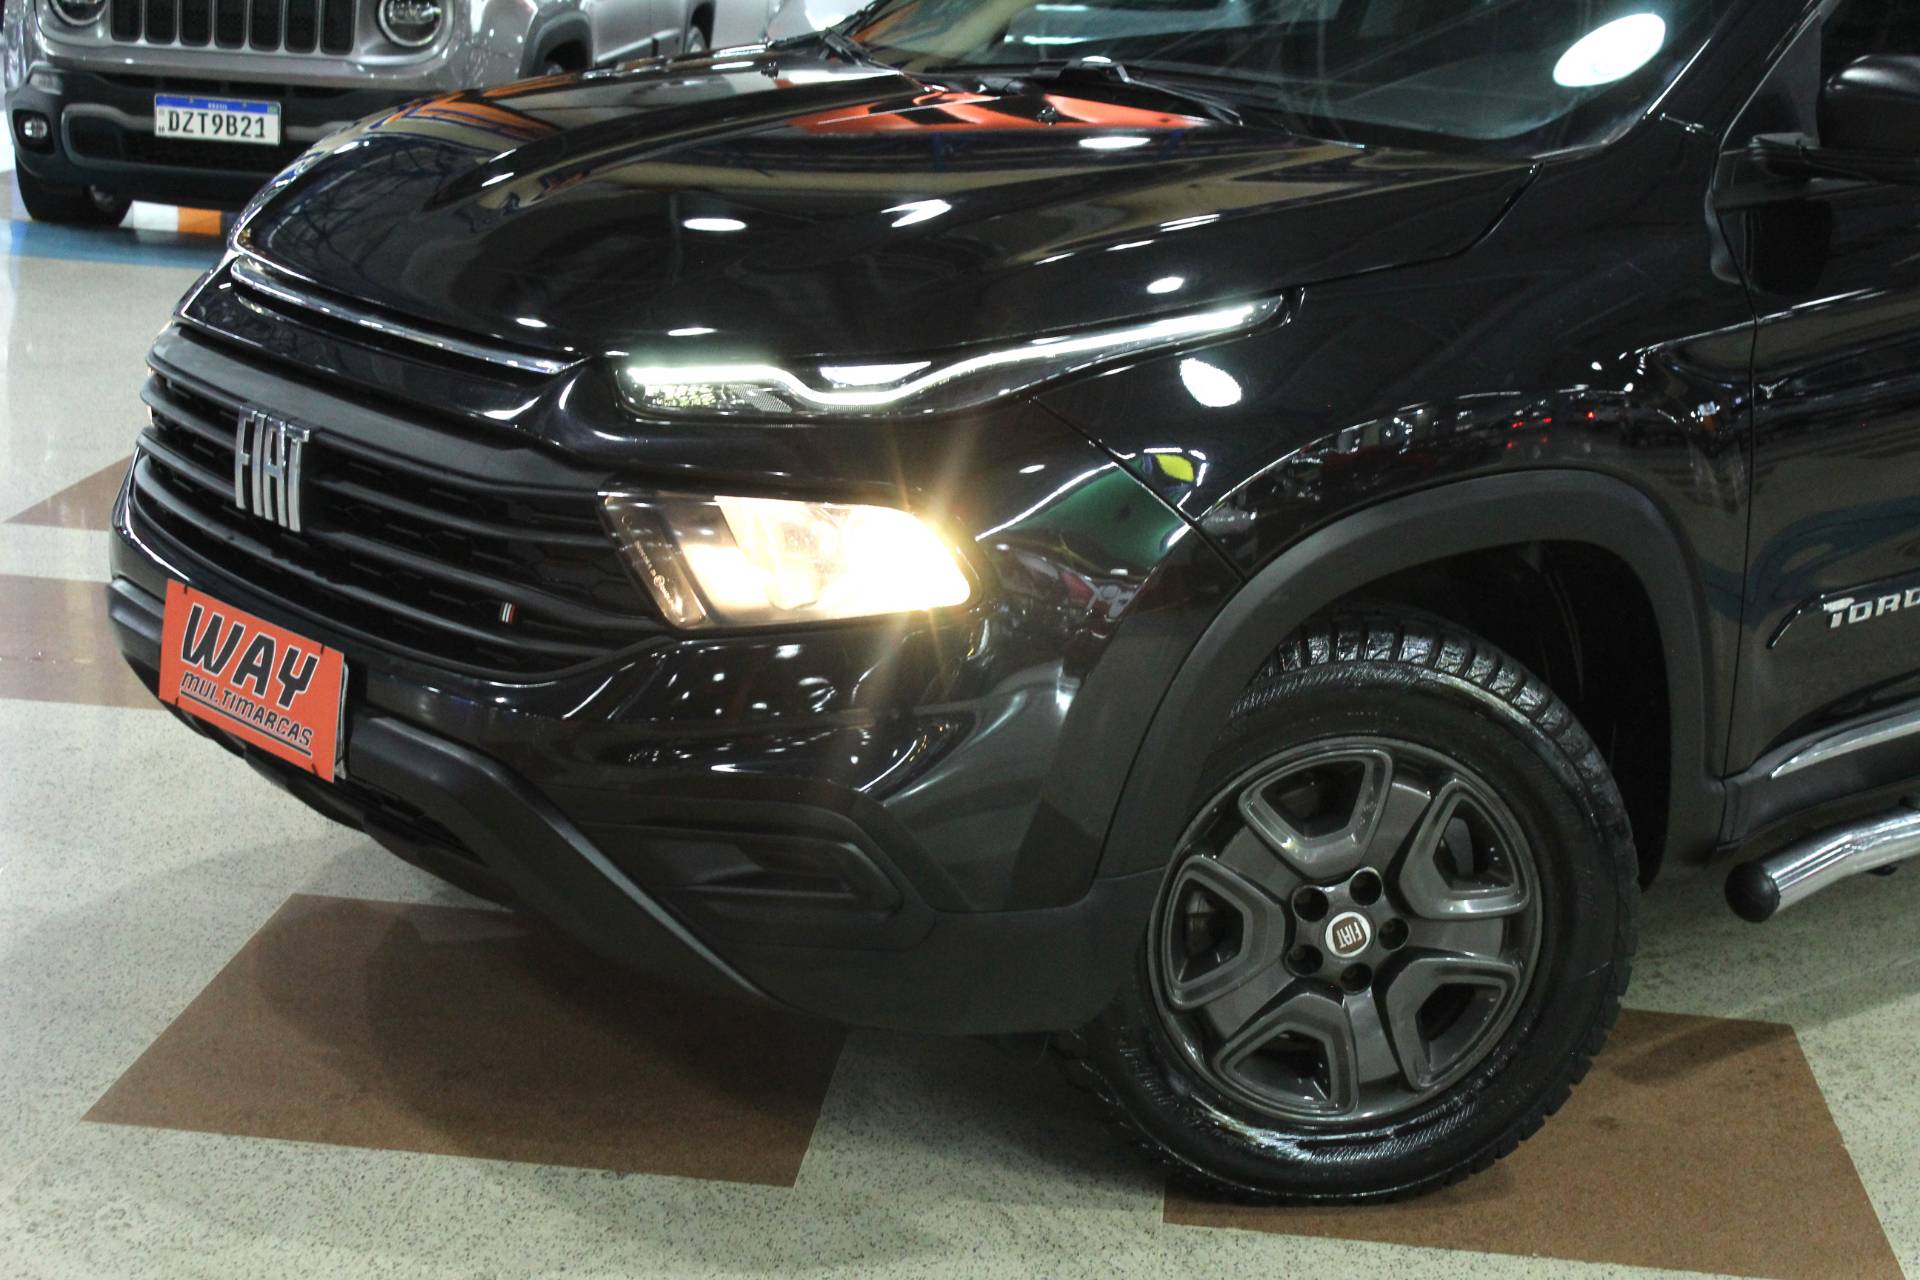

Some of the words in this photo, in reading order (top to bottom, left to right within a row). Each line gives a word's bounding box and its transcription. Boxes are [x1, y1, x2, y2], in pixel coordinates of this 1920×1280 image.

[168, 110, 266, 139] DZT9B21
[235, 406, 310, 533] FIAT
[180, 601, 321, 711] WAY
[181, 671, 313, 747] MULTIMARCAS
[1336, 921, 1363, 950] FIAT
